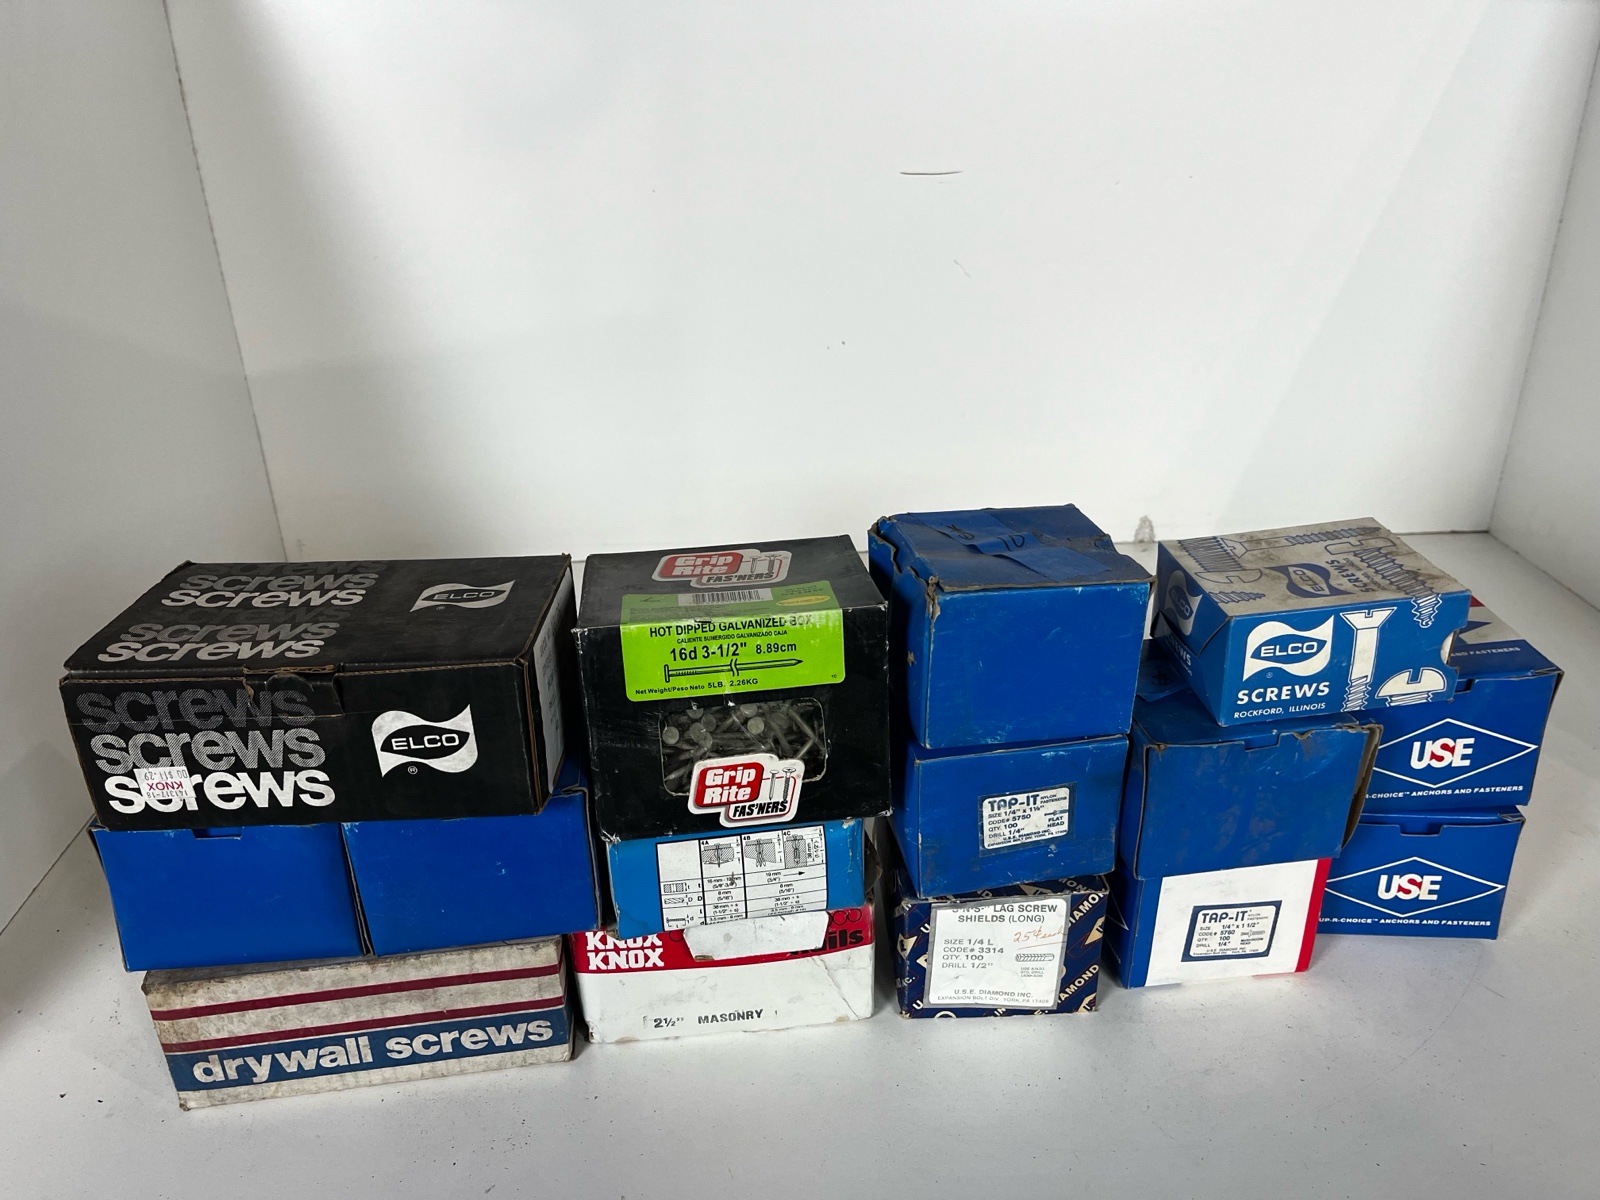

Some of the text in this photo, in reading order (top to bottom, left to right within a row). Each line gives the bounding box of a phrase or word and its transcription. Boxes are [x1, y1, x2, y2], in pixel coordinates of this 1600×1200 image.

[673, 555, 733, 566] Grip
[671, 565, 729, 576] Rite
[1326, 559, 1376, 592] SCREWS
[179, 573, 380, 592] screws
[1293, 569, 1325, 592] ELCO
[161, 589, 367, 608] screws
[433, 591, 496, 600] ELCO
[120, 622, 341, 643] screws
[650, 625, 673, 638] HOT
[675, 622, 716, 636] DIPPED
[718, 616, 787, 632] GALVANIZED
[704, 634, 735, 642] SUMERGIDO
[736, 631, 773, 639] GALVANIZADO
[97, 639, 326, 663] screws
[670, 642, 797, 662] 16d 3-1/2" 8.89cm
[1260, 641, 1318, 657] ELCO
[1469, 647, 1521, 656] FASTENERS
[648, 684, 689, 694] Weight/Peso
[730, 678, 758, 687] 2.26KG
[1236, 682, 1330, 705] SCREWS
[76, 689, 316, 734] screws
[1234, 702, 1326, 718] ROCKFORD, ILLINOIS
[391, 733, 460, 750] ELCO
[90, 728, 326, 774] screws
[1410, 737, 1475, 769] USE
[705, 766, 756, 787] Grip
[146, 781, 184, 792] KNOX
[703, 786, 751, 804] Rite
[1474, 785, 1524, 793] FASTENERS
[733, 800, 788, 818] FAS'NERS
[988, 794, 1040, 812] TAP-IT
[1012, 813, 1031, 822] 5750
[1047, 820, 1065, 828] HEAD
[1377, 873, 1442, 900] USE
[993, 904, 1014, 913] LAG
[1017, 904, 1058, 912] SCREW
[1202, 911, 1248, 923] TAP-IT
[958, 915, 1045, 923] SHIELDS (LONG)
[968, 938, 984, 946] 1/4
[587, 947, 664, 970] KNOX
[697, 1009, 764, 1024] MASONRY
[193, 1019, 554, 1084] drywall screws
